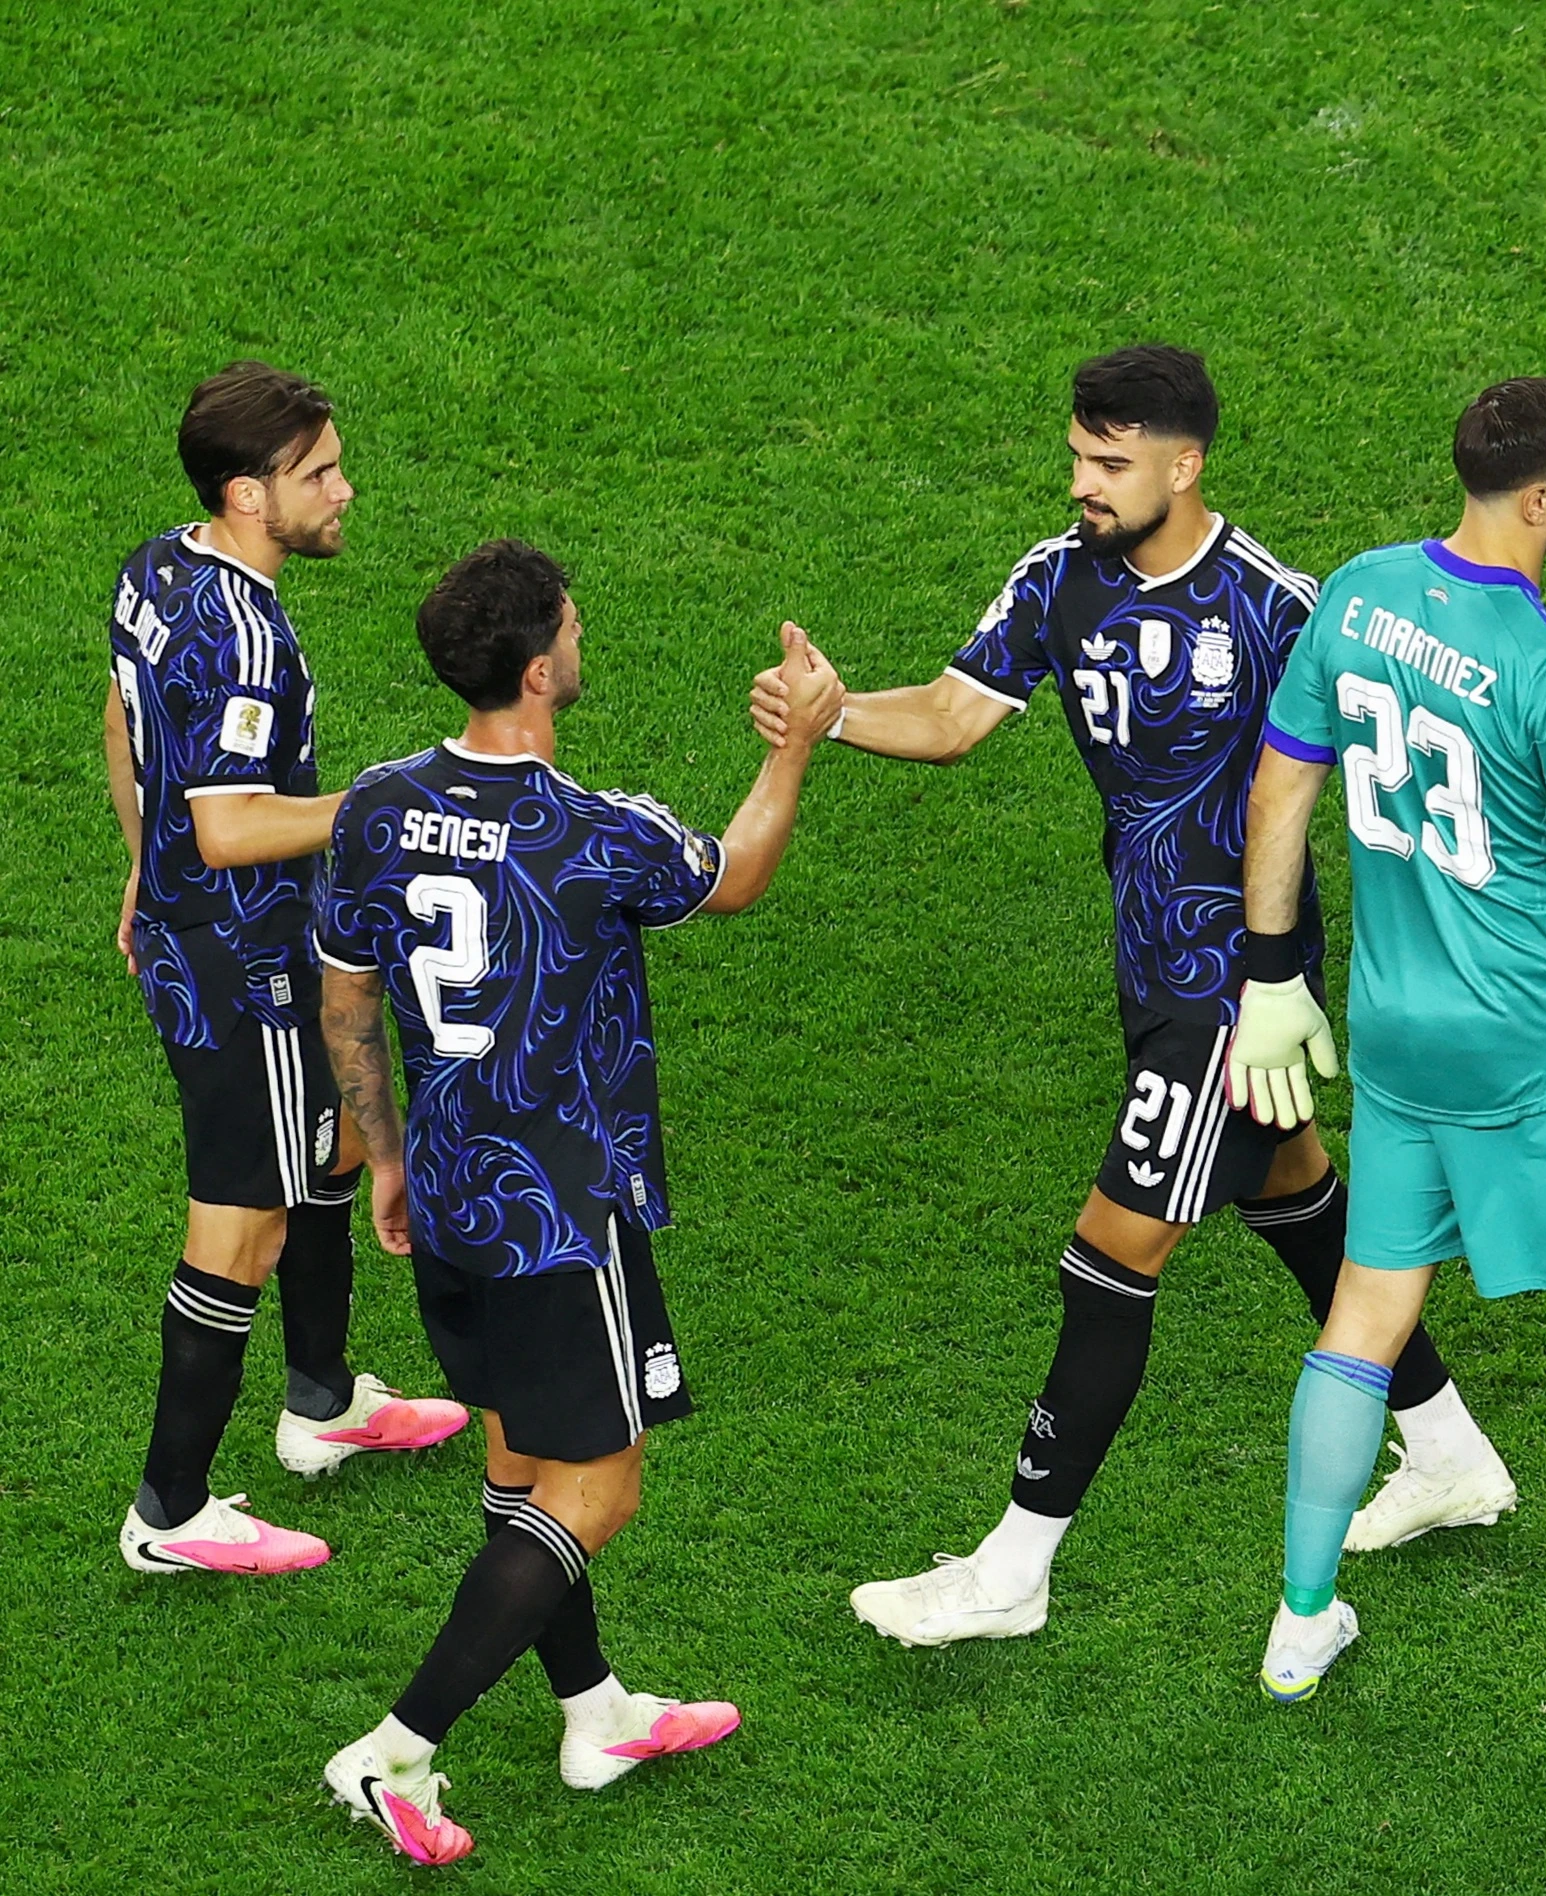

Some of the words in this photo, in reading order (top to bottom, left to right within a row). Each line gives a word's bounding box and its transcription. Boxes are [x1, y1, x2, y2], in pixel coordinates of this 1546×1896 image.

[1341, 596, 1364, 630] E.
[1364, 607, 1498, 707] MARTINEZ
[1073, 669, 1131, 748] 21
[1336, 672, 1497, 890] 23
[401, 809, 511, 862] SENESI
[406, 874, 495, 1060] 2
[1121, 1069, 1192, 1159] 21
